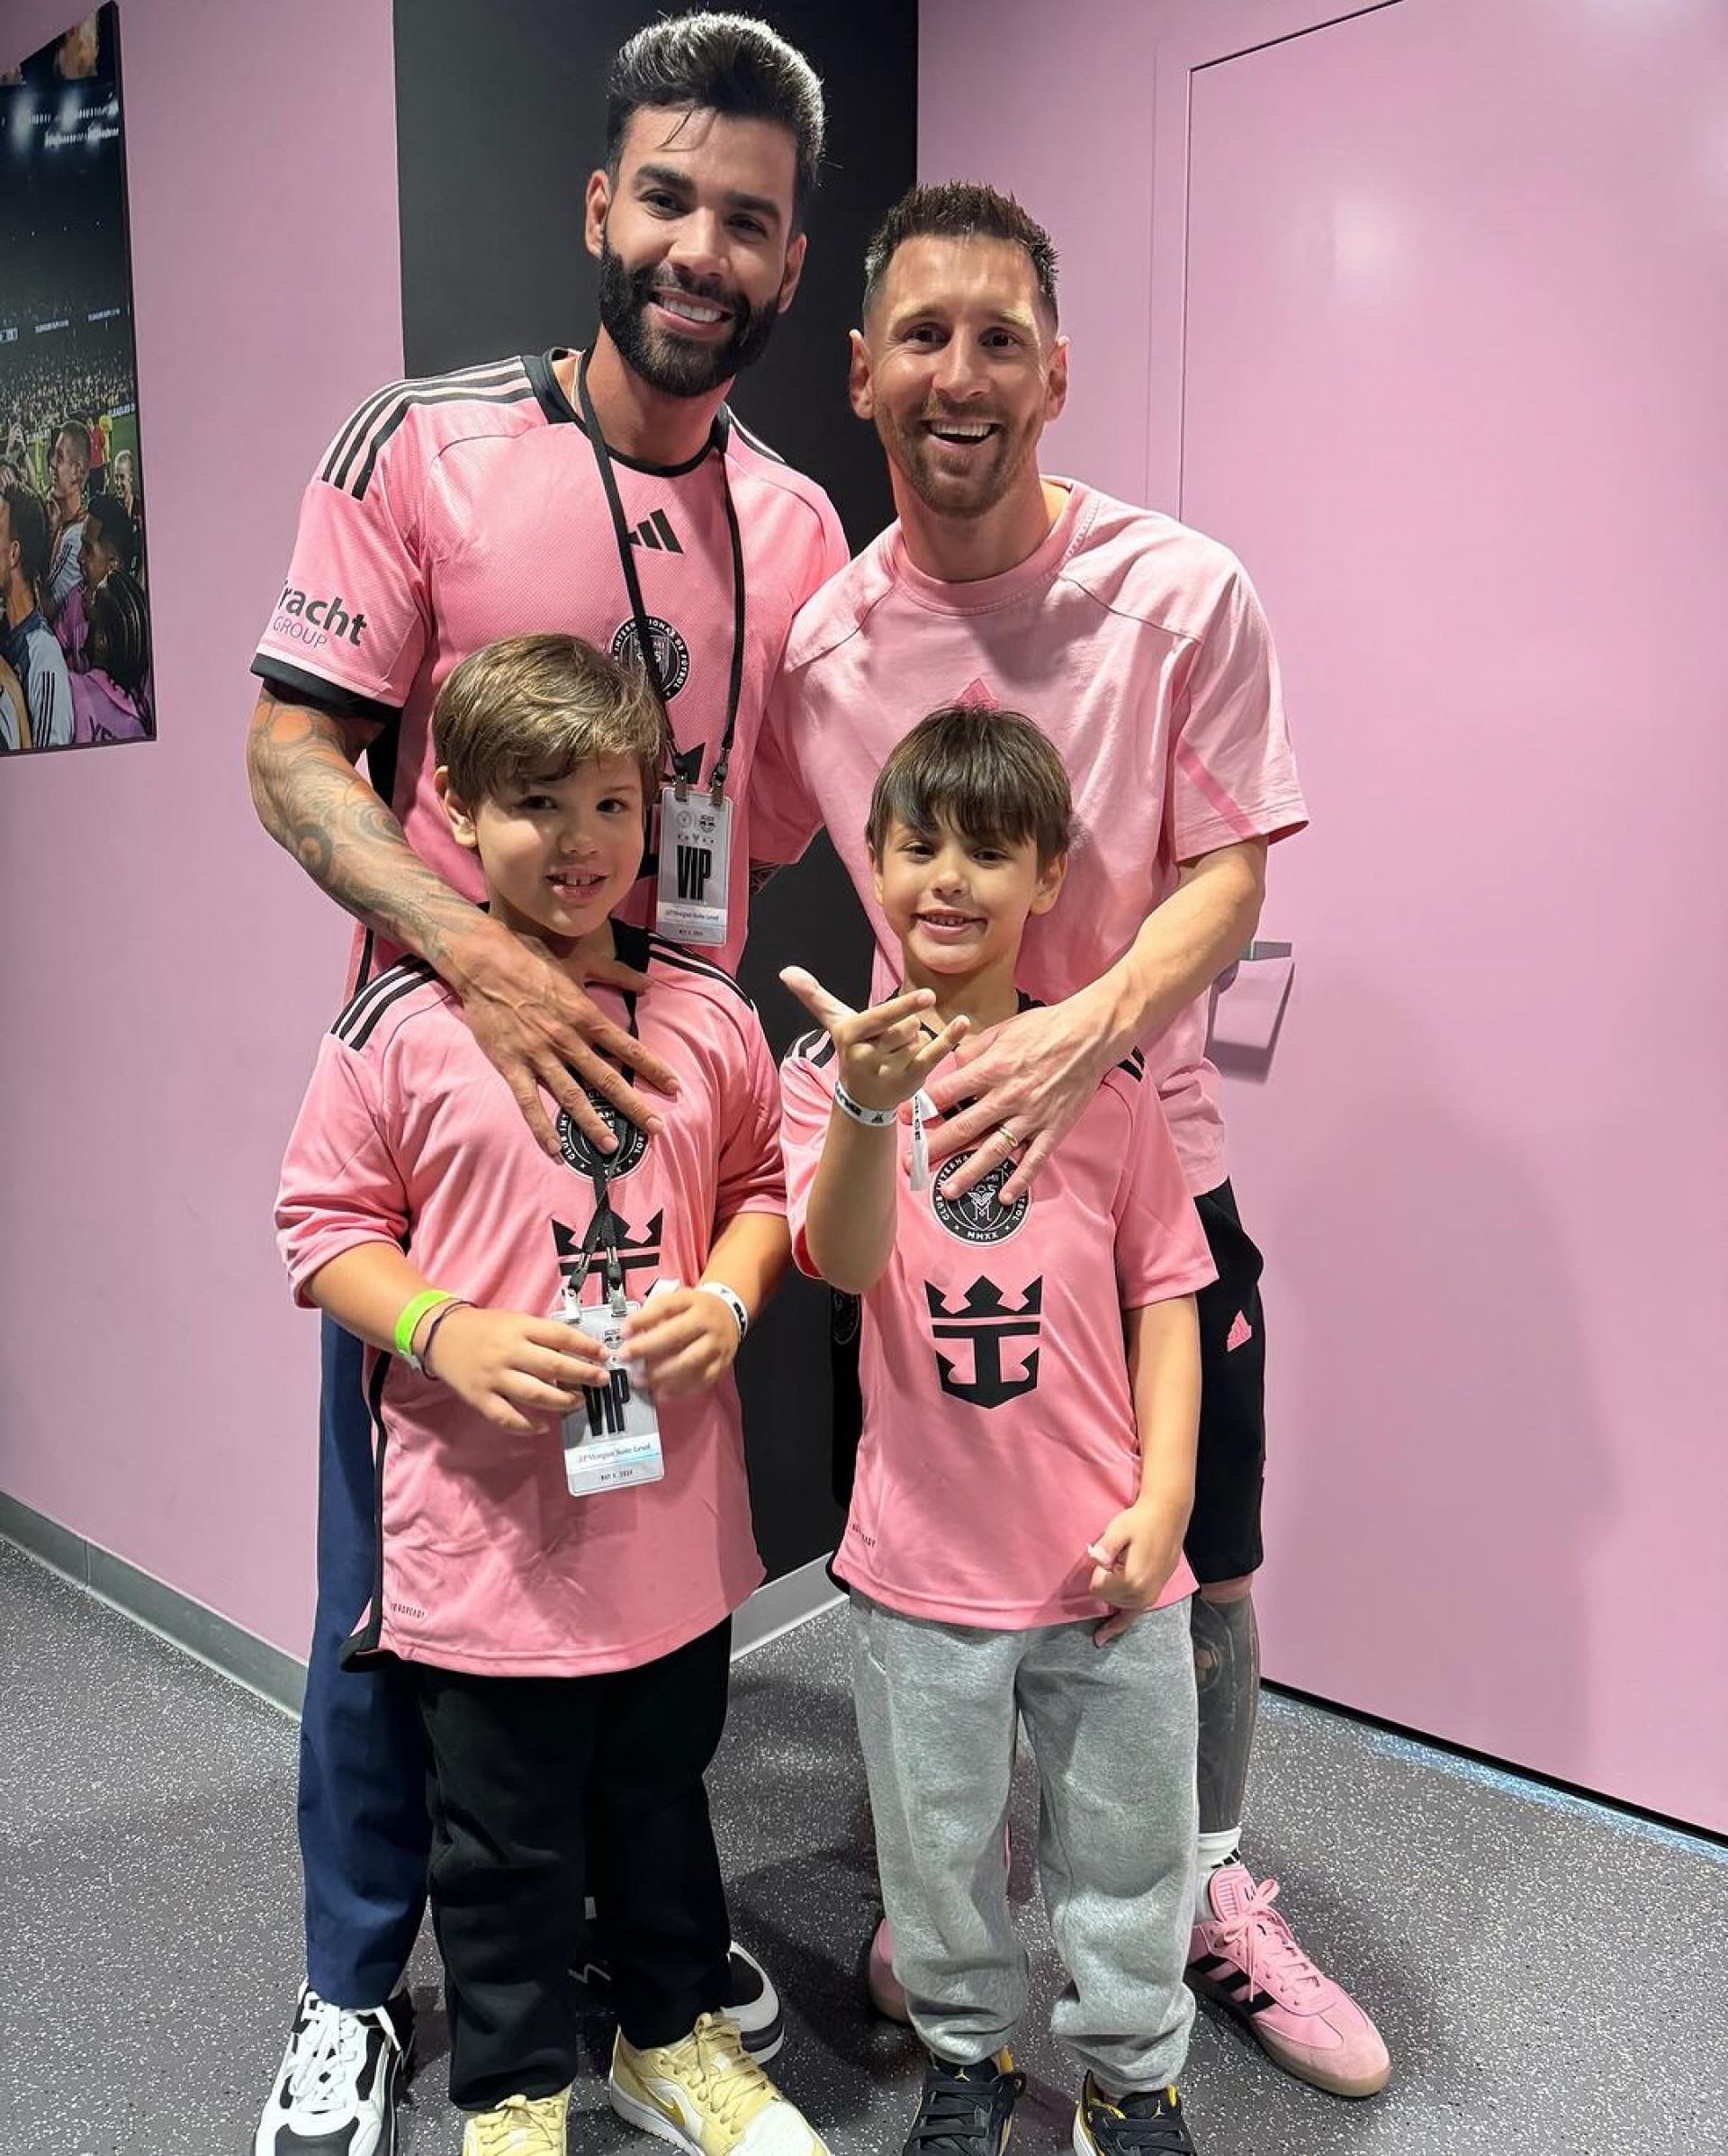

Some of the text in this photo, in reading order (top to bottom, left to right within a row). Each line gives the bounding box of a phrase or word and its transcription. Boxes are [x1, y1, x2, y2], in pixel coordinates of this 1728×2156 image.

[273, 616, 328, 648] GROUP
[277, 579, 367, 646] racht
[676, 844, 713, 901] VIP
[967, 1231, 999, 1240] MMXX
[581, 1367, 632, 1438] VIP
